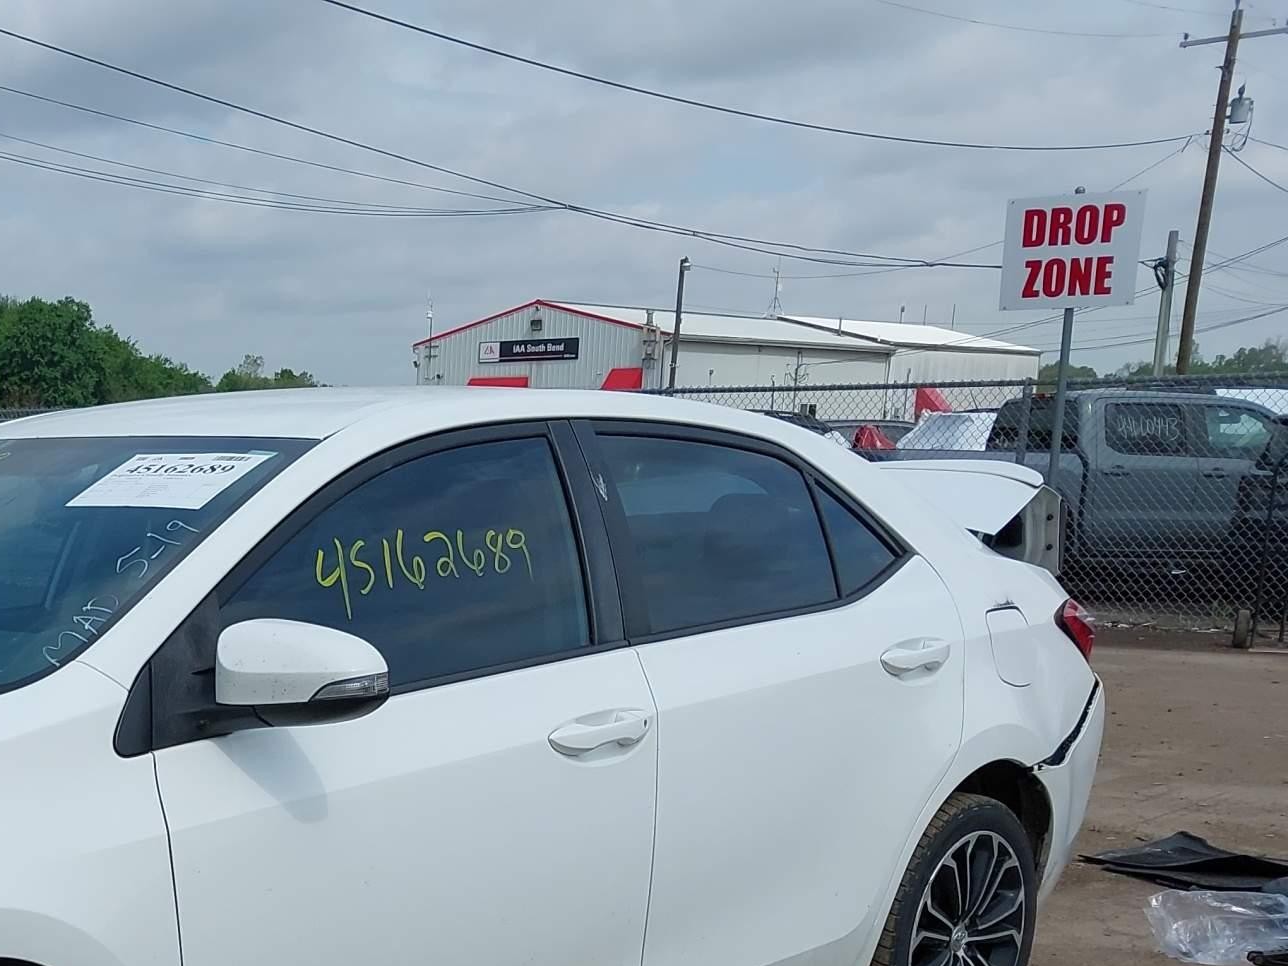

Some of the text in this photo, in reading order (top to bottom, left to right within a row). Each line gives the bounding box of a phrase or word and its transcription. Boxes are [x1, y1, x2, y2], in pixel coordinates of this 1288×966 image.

[1022, 203, 1127, 248] DROP
[1021, 256, 1115, 299] ZONE
[526, 343, 546, 353] South
[547, 342, 565, 352] Bend
[125, 463, 236, 476] 45162689
[115, 519, 201, 579] 5-19
[315, 528, 535, 621] 45162689
